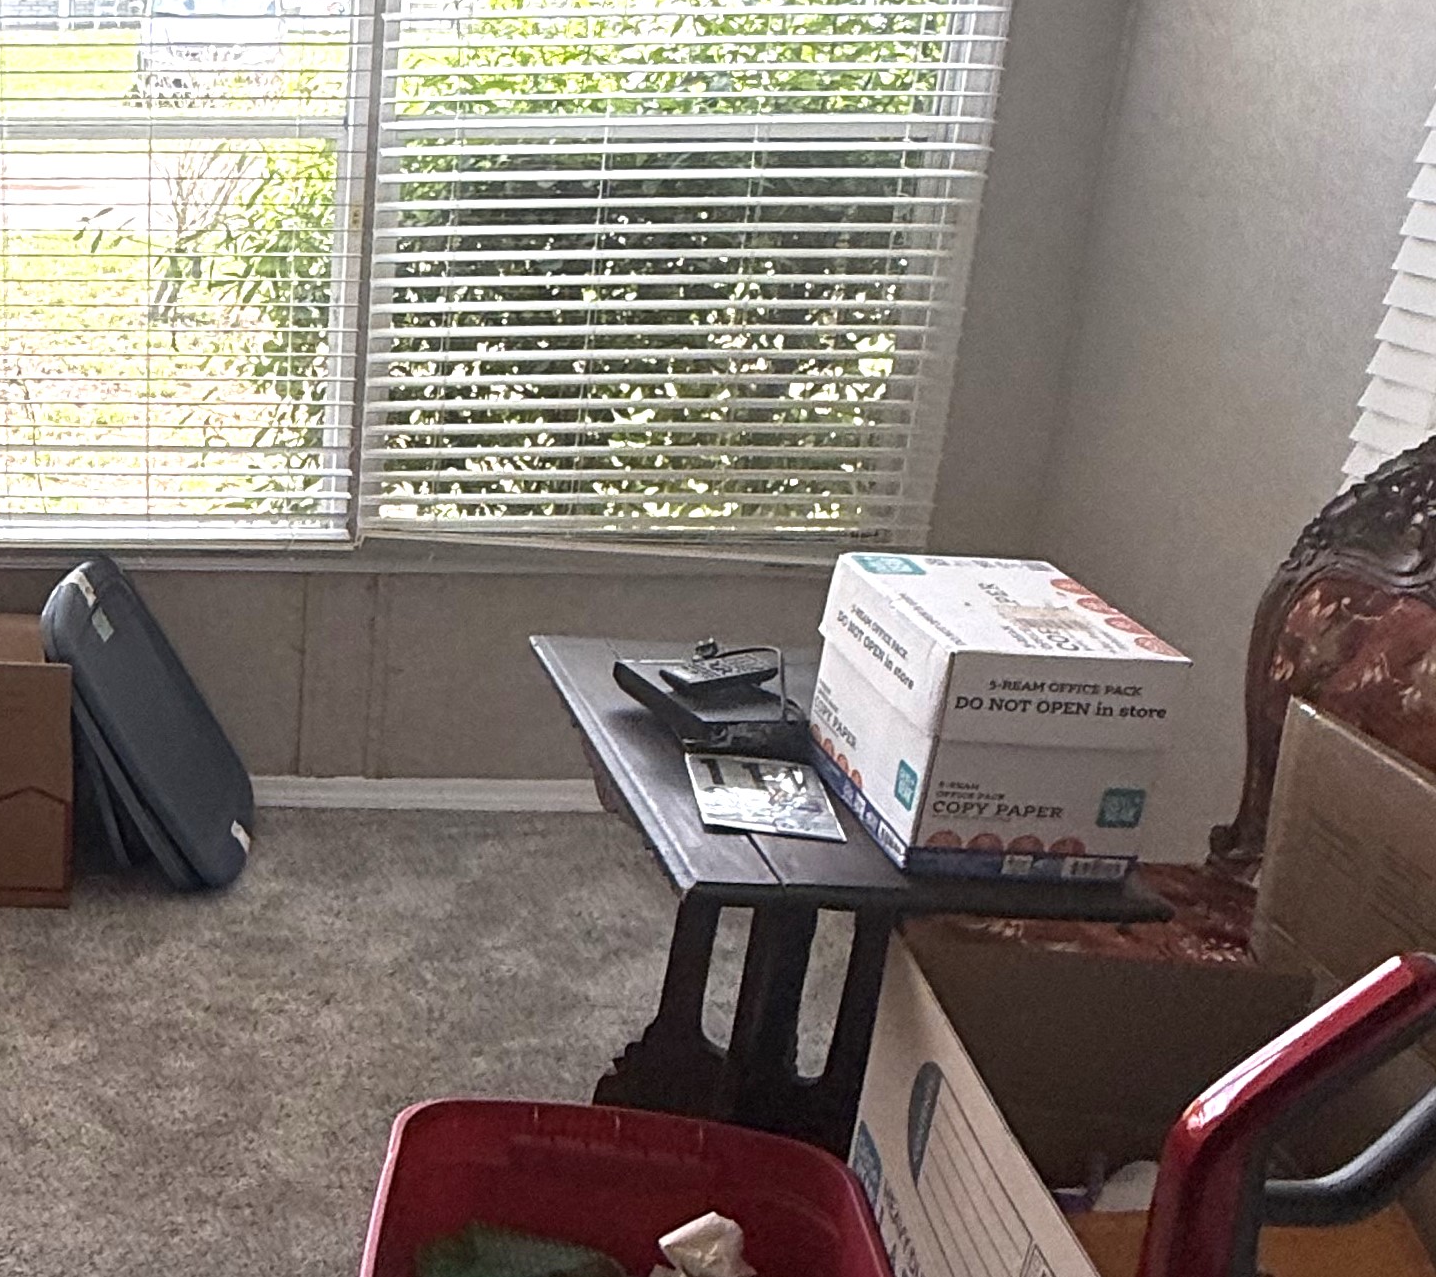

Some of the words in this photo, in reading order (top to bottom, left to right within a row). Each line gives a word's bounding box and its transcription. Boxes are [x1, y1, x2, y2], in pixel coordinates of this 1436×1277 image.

[1048, 681, 1100, 695] OFFICE
[1104, 684, 1143, 697] PACK
[954, 696, 983, 711] DO
[988, 697, 1032, 713] NOT
[1035, 700, 1091, 716] OPEN
[1095, 701, 1114, 717] in
[1119, 704, 1168, 719] store
[932, 800, 990, 816] COPY
[995, 804, 1065, 819] PAPER
